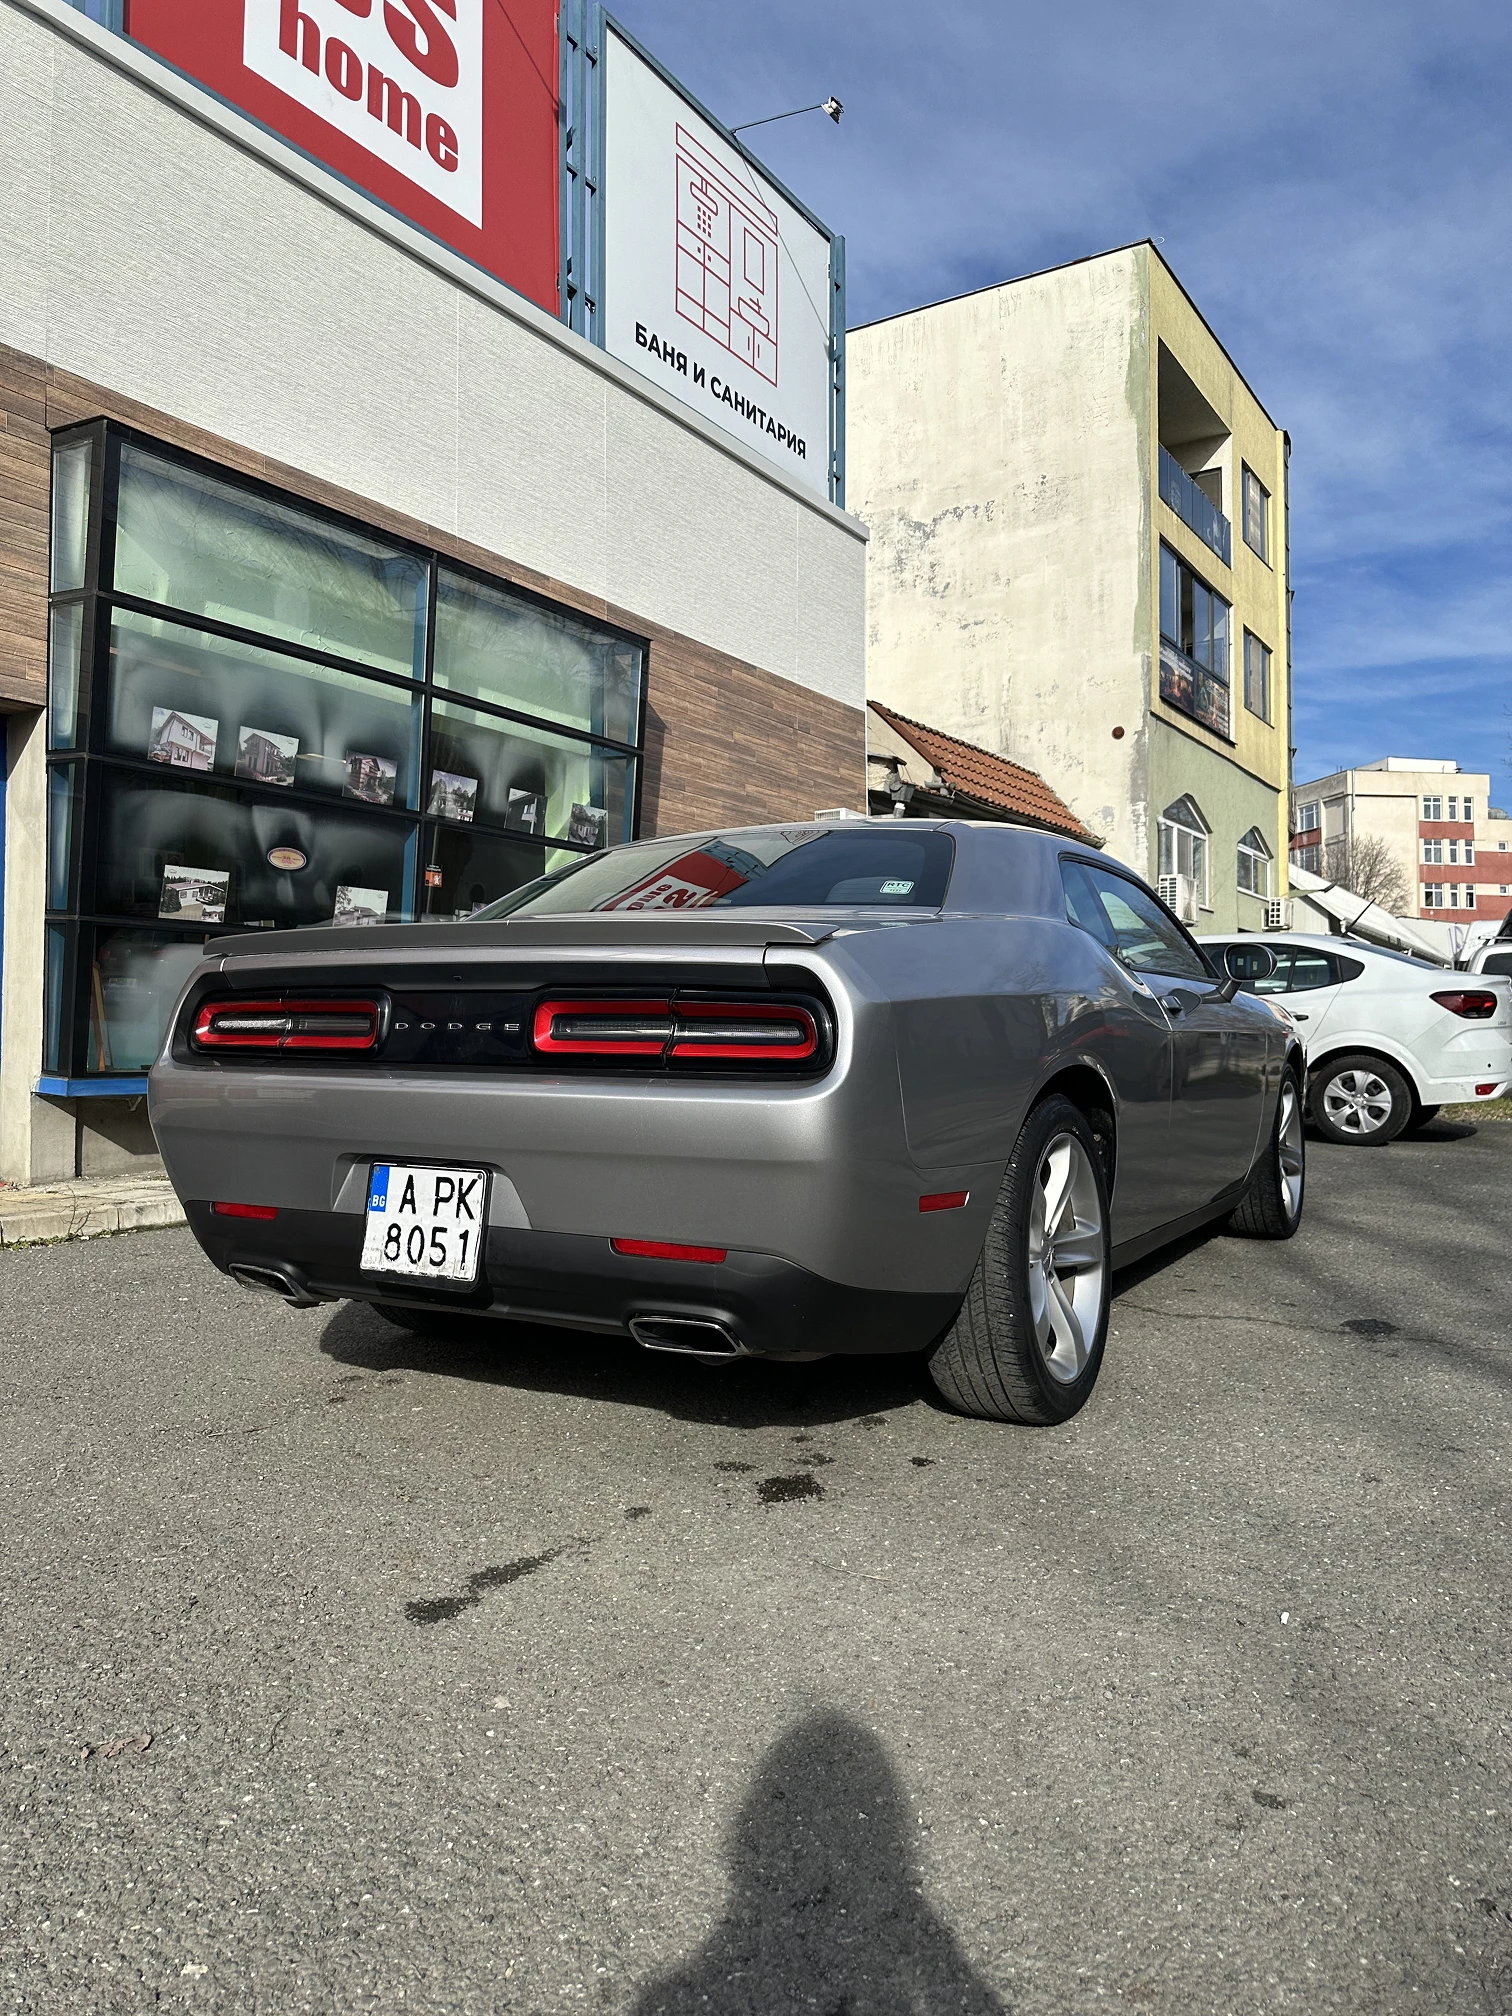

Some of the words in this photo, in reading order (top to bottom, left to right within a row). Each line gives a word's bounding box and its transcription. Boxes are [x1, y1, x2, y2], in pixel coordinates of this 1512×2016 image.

[278, 0, 459, 173] home
[635, 320, 688, 377] БАНЯ
[693, 361, 706, 389] И
[711, 380, 807, 460] САНИТАРИЯ
[394, 1022, 520, 1031] DODGE
[372, 1194, 386, 1208] BG
[398, 1174, 417, 1214] A
[432, 1176, 479, 1220] PK
[383, 1222, 470, 1271] 8051
